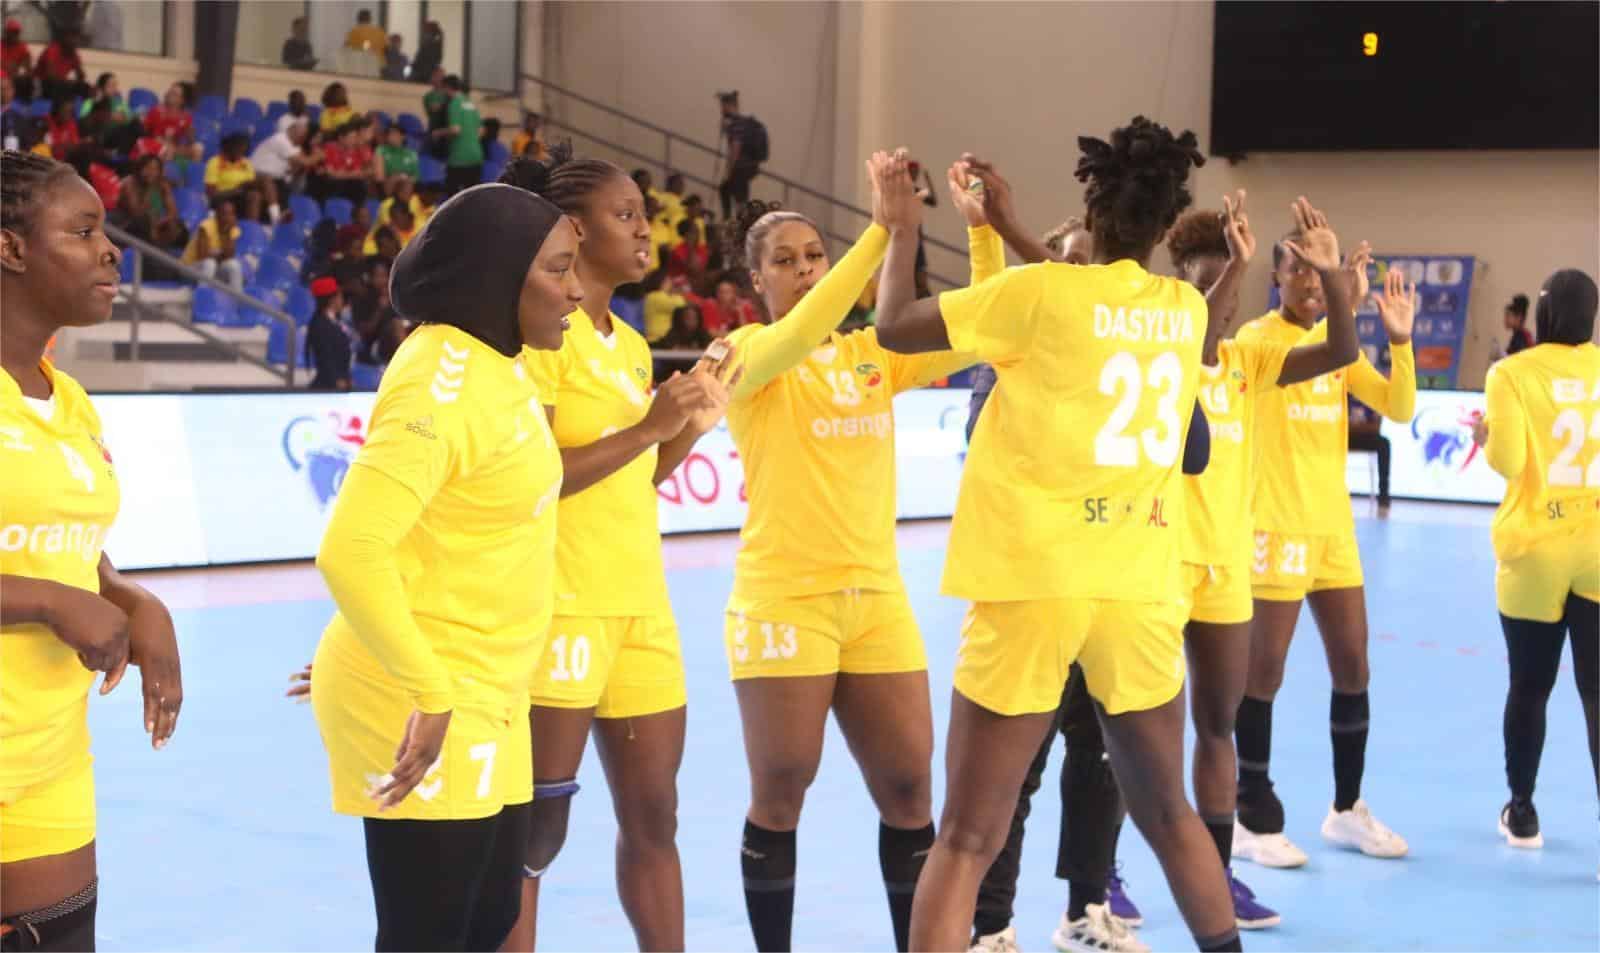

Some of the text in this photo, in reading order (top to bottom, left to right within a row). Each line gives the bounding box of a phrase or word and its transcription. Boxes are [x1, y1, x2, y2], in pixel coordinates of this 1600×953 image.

[1363, 32, 1378, 56] 9
[1093, 303, 1194, 343] DASYLVA
[826, 370, 860, 407] 13
[1094, 350, 1184, 467] 23
[1281, 542, 1306, 575] 21
[551, 635, 590, 681] 10
[760, 622, 799, 659] 13
[469, 741, 497, 798] 7
